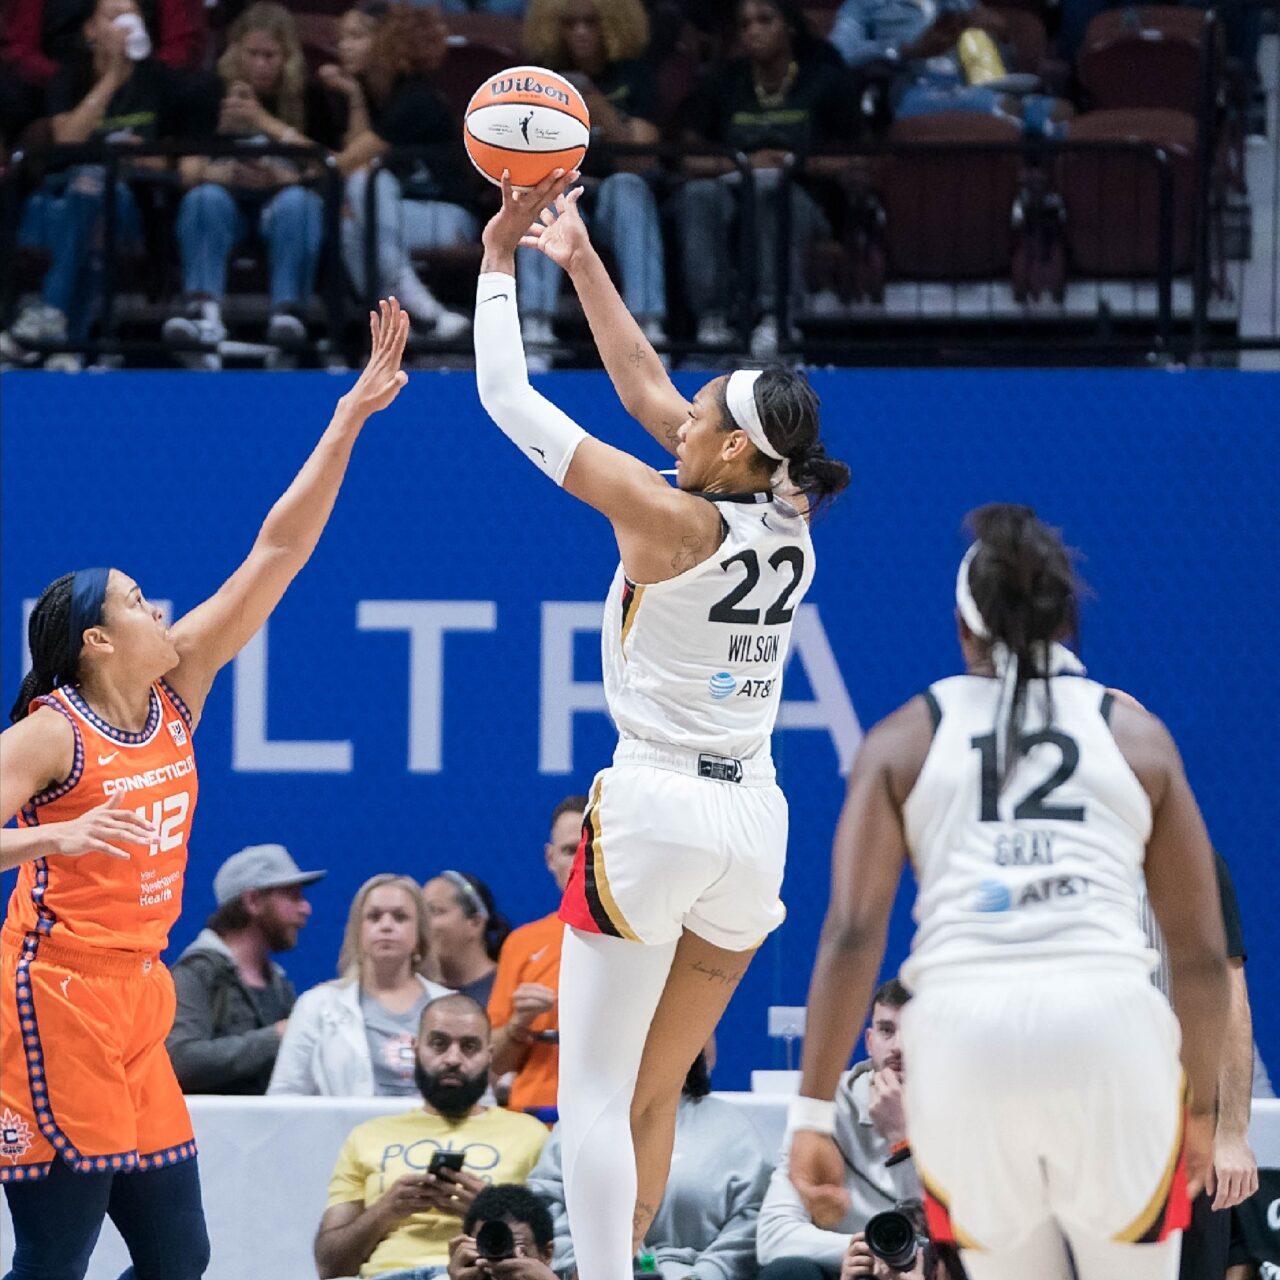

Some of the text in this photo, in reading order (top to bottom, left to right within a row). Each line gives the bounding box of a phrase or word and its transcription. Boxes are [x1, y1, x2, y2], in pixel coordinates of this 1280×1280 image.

[491, 76, 570, 106] Wilson
[708, 545, 804, 625] 22
[728, 634, 780, 662] WILSON
[970, 730, 1086, 822] 12
[135, 791, 190, 857] 42
[995, 831, 1056, 867] GRAY
